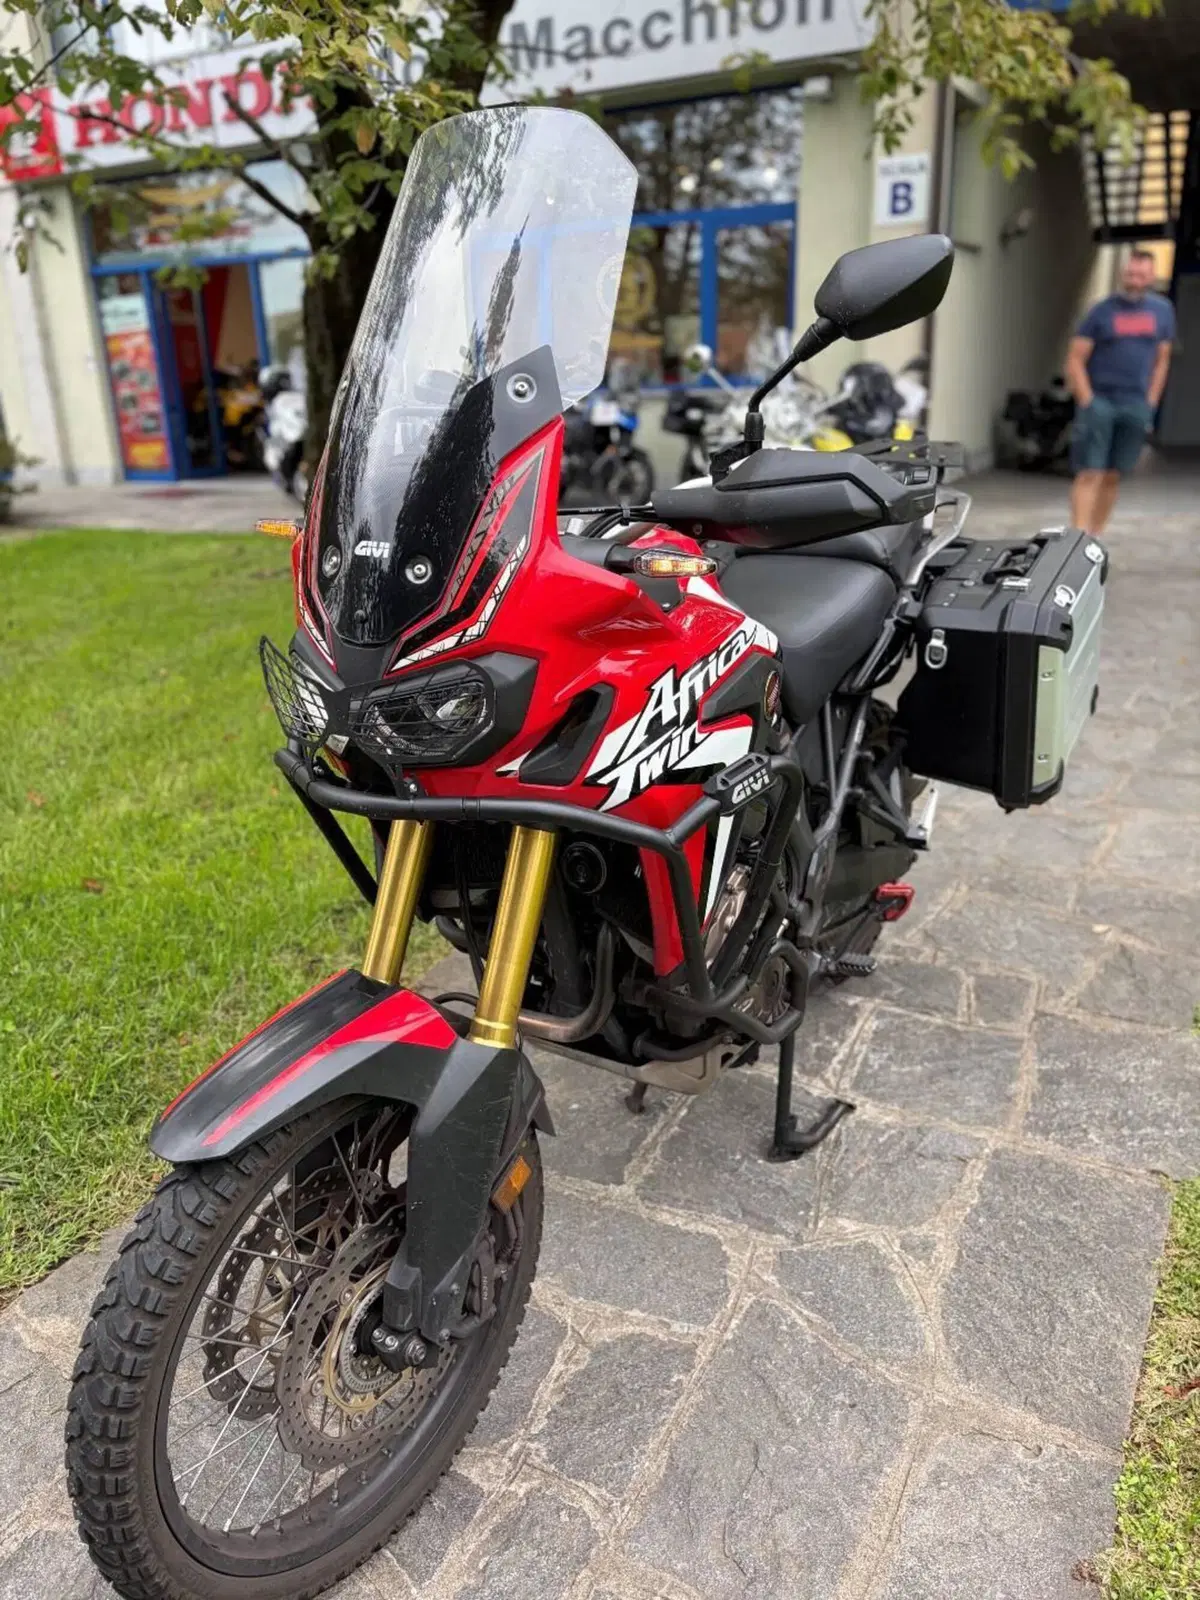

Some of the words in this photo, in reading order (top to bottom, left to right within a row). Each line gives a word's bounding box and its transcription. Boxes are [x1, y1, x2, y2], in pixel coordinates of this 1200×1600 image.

[890, 182, 913, 216] B
[354, 540, 391, 559] GIVI
[617, 629, 756, 765] Africa
[731, 767, 771, 805] GIVI
